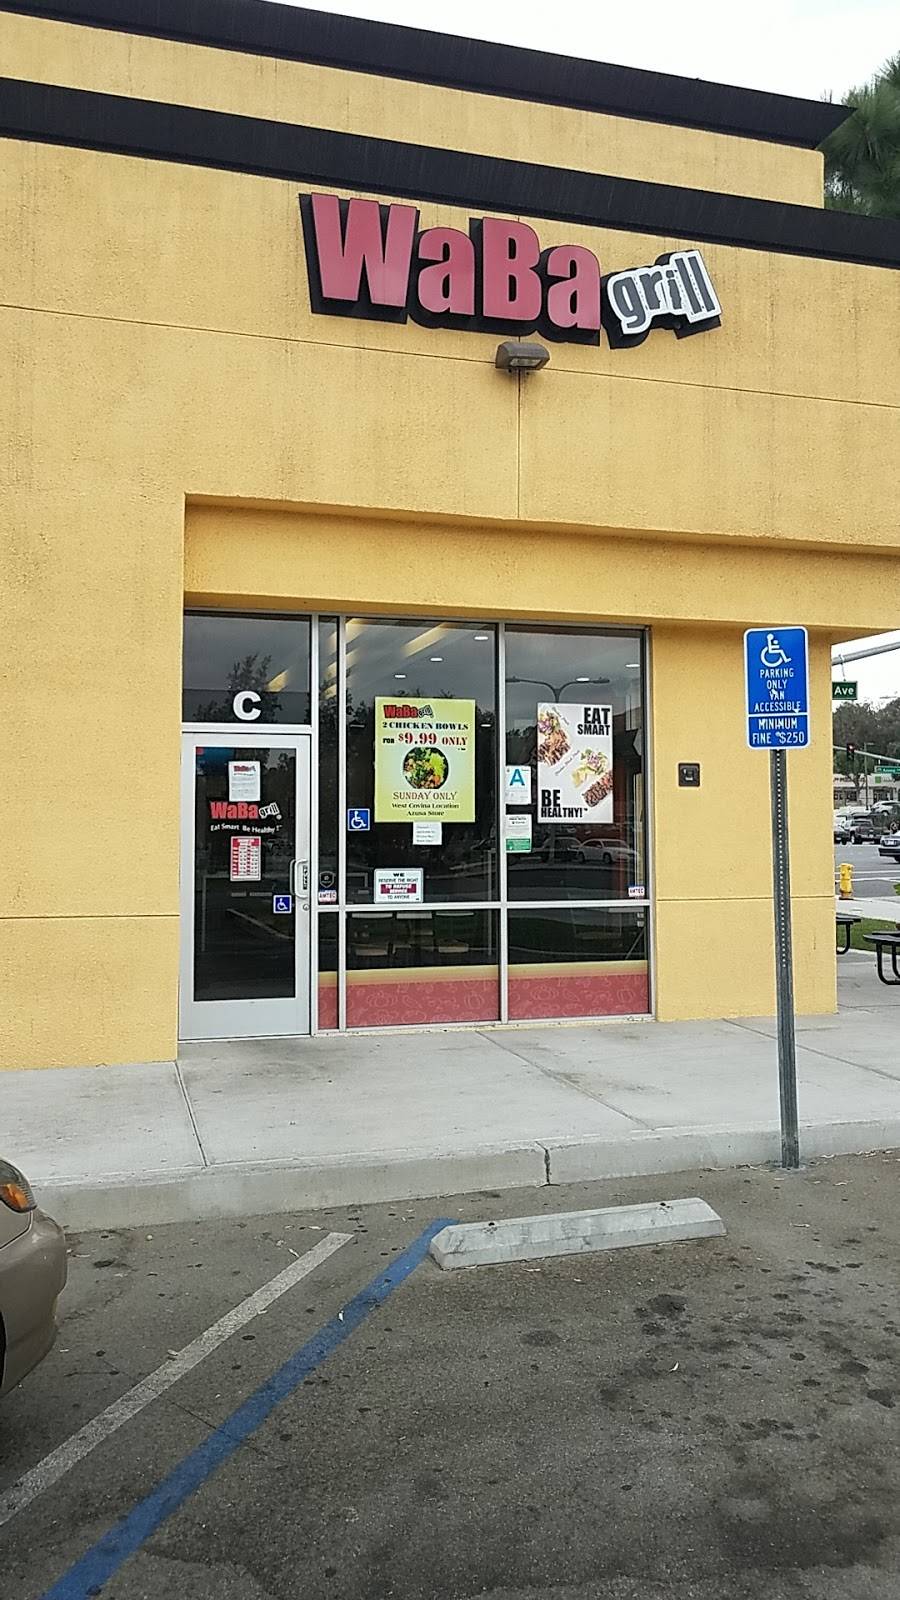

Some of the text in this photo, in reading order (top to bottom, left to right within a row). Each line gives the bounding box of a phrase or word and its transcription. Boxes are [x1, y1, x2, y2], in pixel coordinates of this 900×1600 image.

[310, 191, 721, 335] WaBa grill
[760, 668, 794, 679] PARKING
[766, 679, 788, 690] ONLY
[834, 685, 853, 696] Ave
[769, 690, 785, 701] VAN
[233, 691, 261, 720] C
[383, 704, 418, 719] WaBa
[754, 701, 801, 713] ACCESSIBLE
[583, 707, 610, 725] EAT
[382, 721, 469, 731] 2 CHICKEN BOWLS
[758, 717, 797, 730] MINIMUM
[577, 724, 611, 736] SMART
[398, 731, 438, 746] $9.99
[441, 736, 468, 746] ONLY
[752, 730, 804, 745] FINE $250
[509, 768, 525, 786] A
[393, 791, 457, 801] SUNDAY ONLY
[541, 789, 561, 808] BE
[210, 801, 280, 820] WaBa grill
[541, 807, 583, 818] HEALTHY!
[210, 824, 220, 832] Eat
